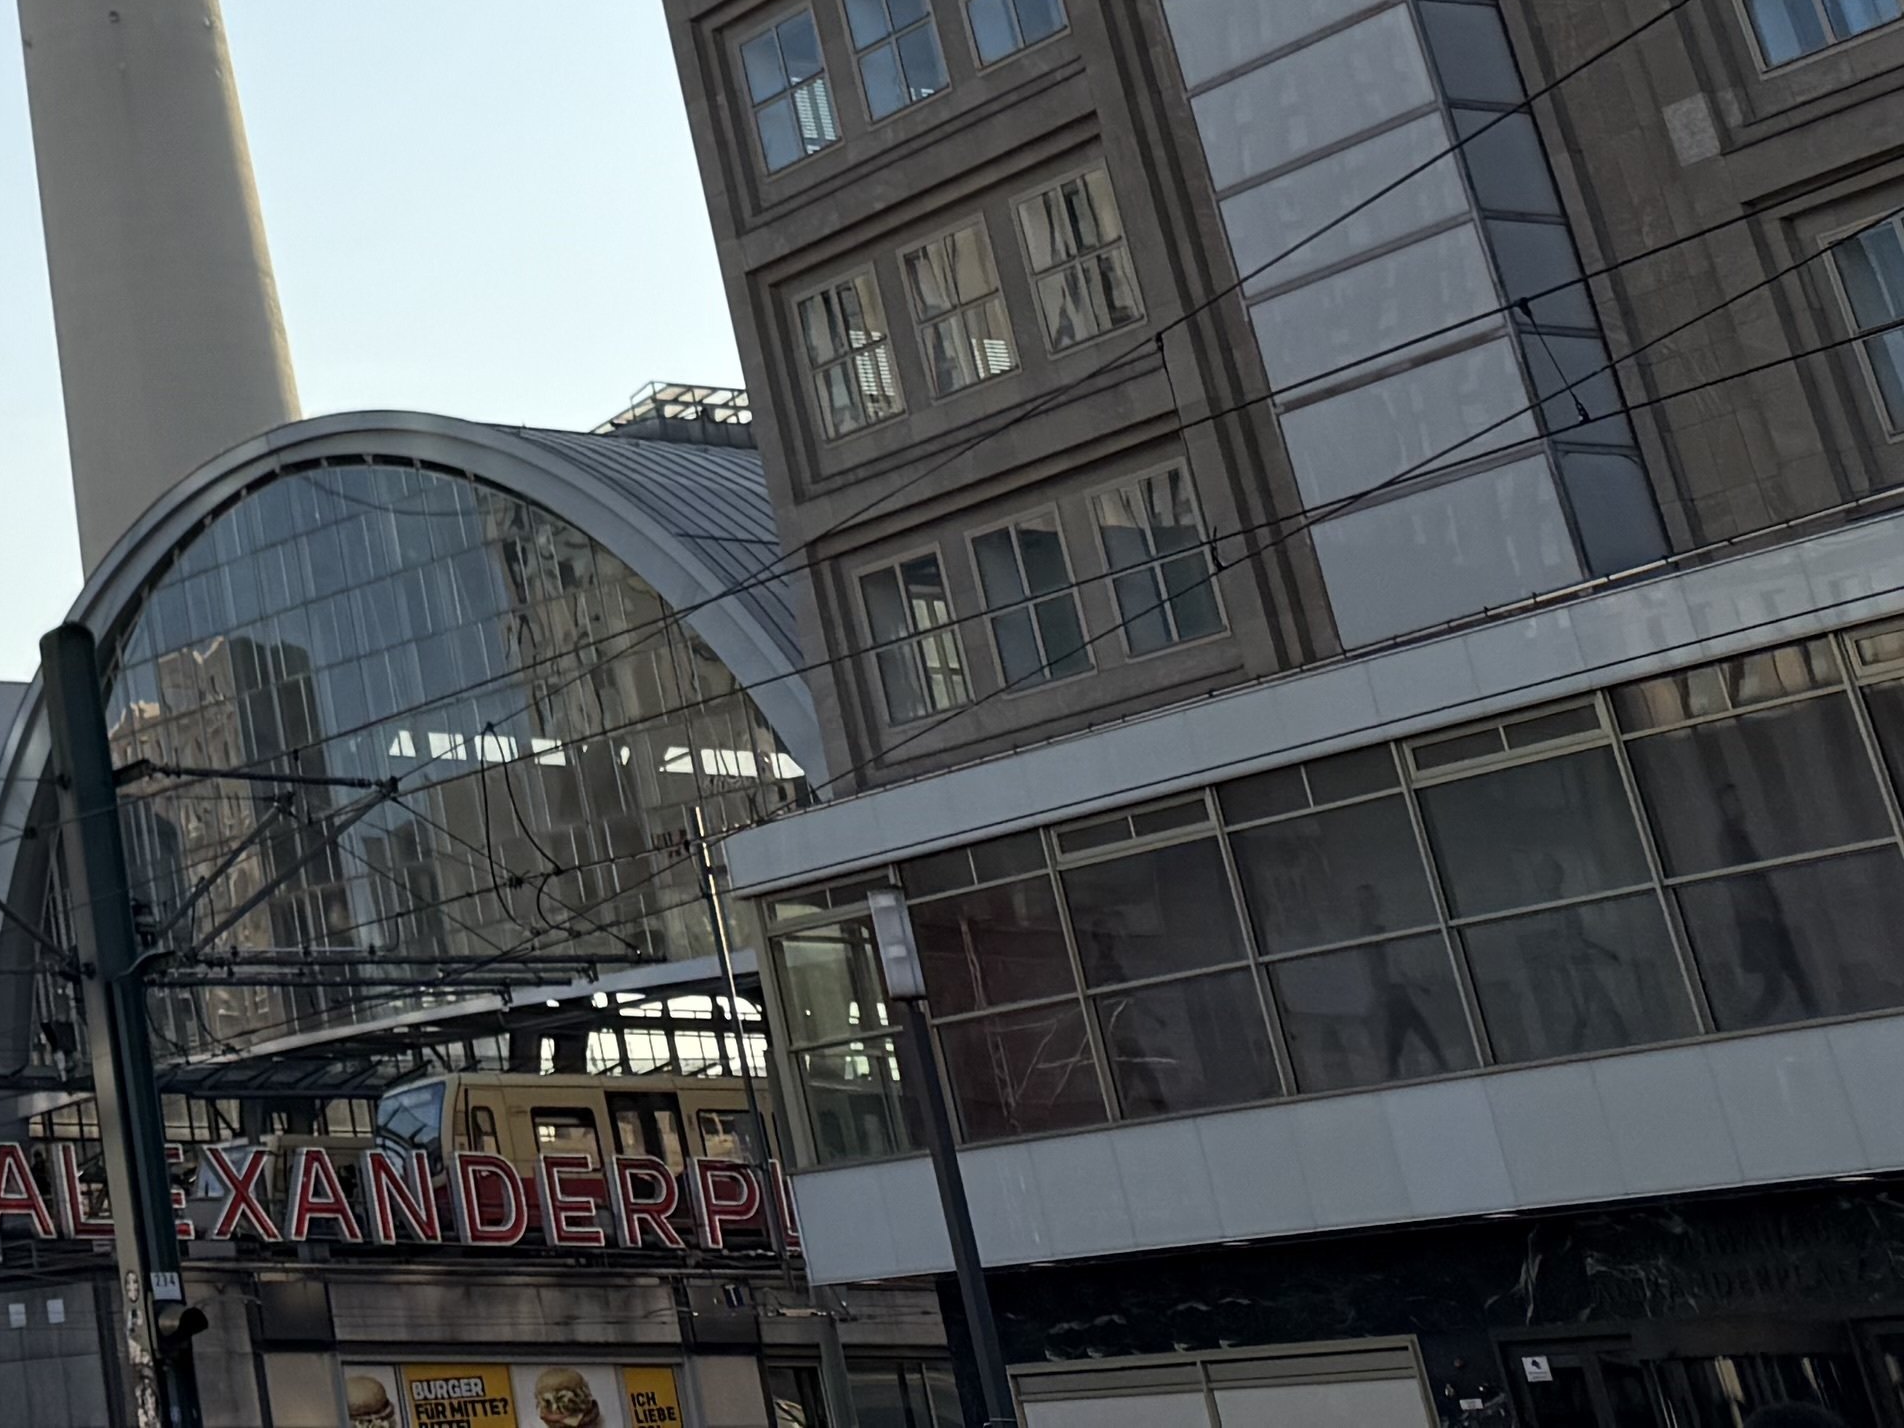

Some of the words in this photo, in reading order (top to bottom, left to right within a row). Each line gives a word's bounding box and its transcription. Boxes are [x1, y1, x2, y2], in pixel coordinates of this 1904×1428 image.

[412, 1379, 484, 1400] BURGER
[450, 1398, 508, 1418] MITTE?
[632, 1392, 657, 1408] ICH
[634, 1406, 677, 1425] LIEBE
